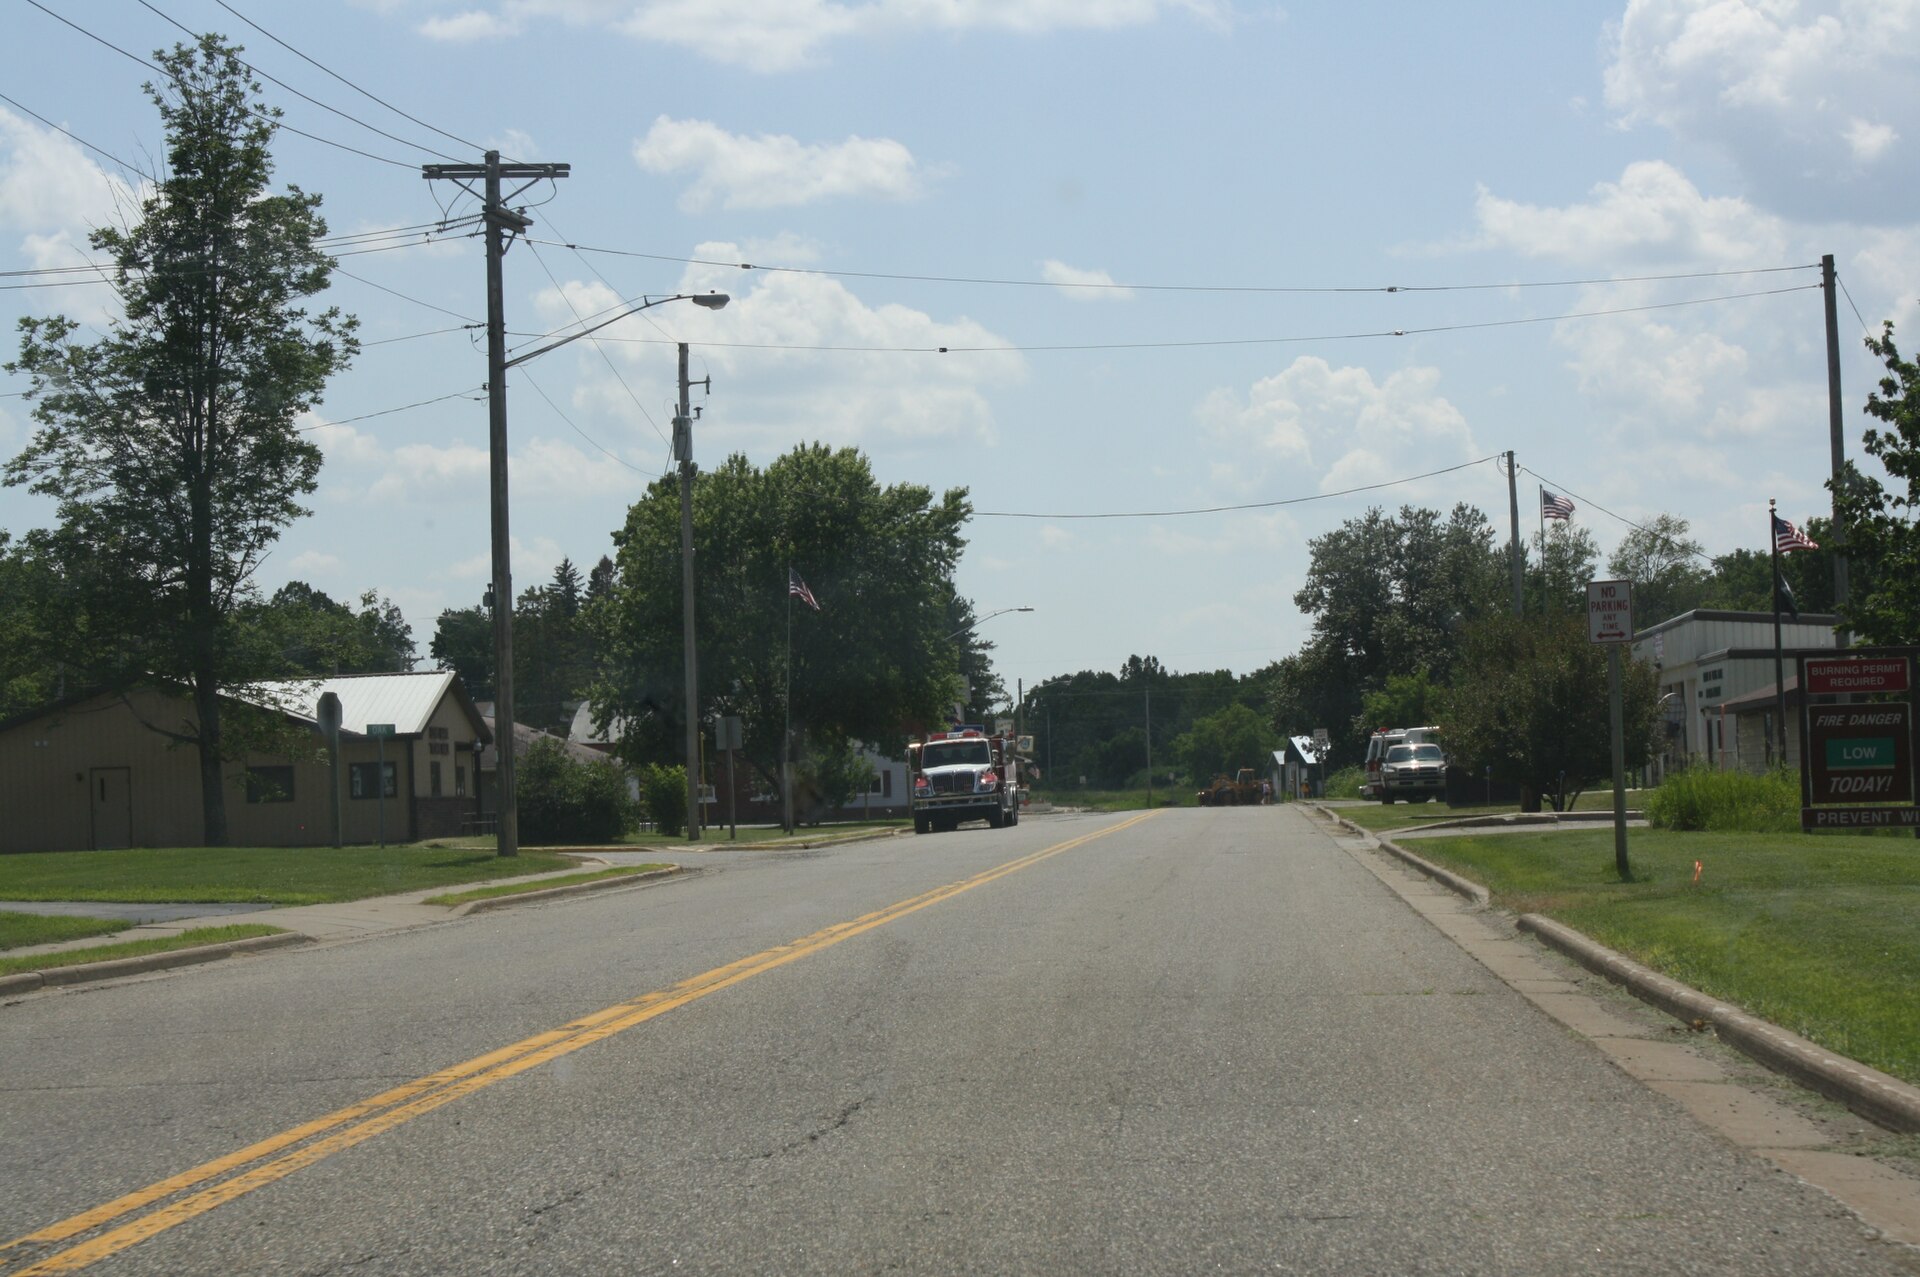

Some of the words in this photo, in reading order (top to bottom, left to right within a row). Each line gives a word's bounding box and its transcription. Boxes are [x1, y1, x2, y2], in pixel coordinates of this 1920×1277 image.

[1601, 586, 1616, 598] NO
[1590, 600, 1628, 613] PARKING
[1603, 613, 1616, 621] ANY
[1602, 623, 1619, 631] TIME
[1811, 665, 1860, 676] BURNING
[1862, 663, 1902, 674] PERMIT
[1830, 676, 1885, 687] REQUIRED
[1816, 714, 1845, 727] FIRE
[1848, 712, 1902, 726] DANGER
[1843, 747, 1877, 760] LOW
[1830, 776, 1892, 793] TODAY!
[1816, 811, 1892, 824] PREVENT
